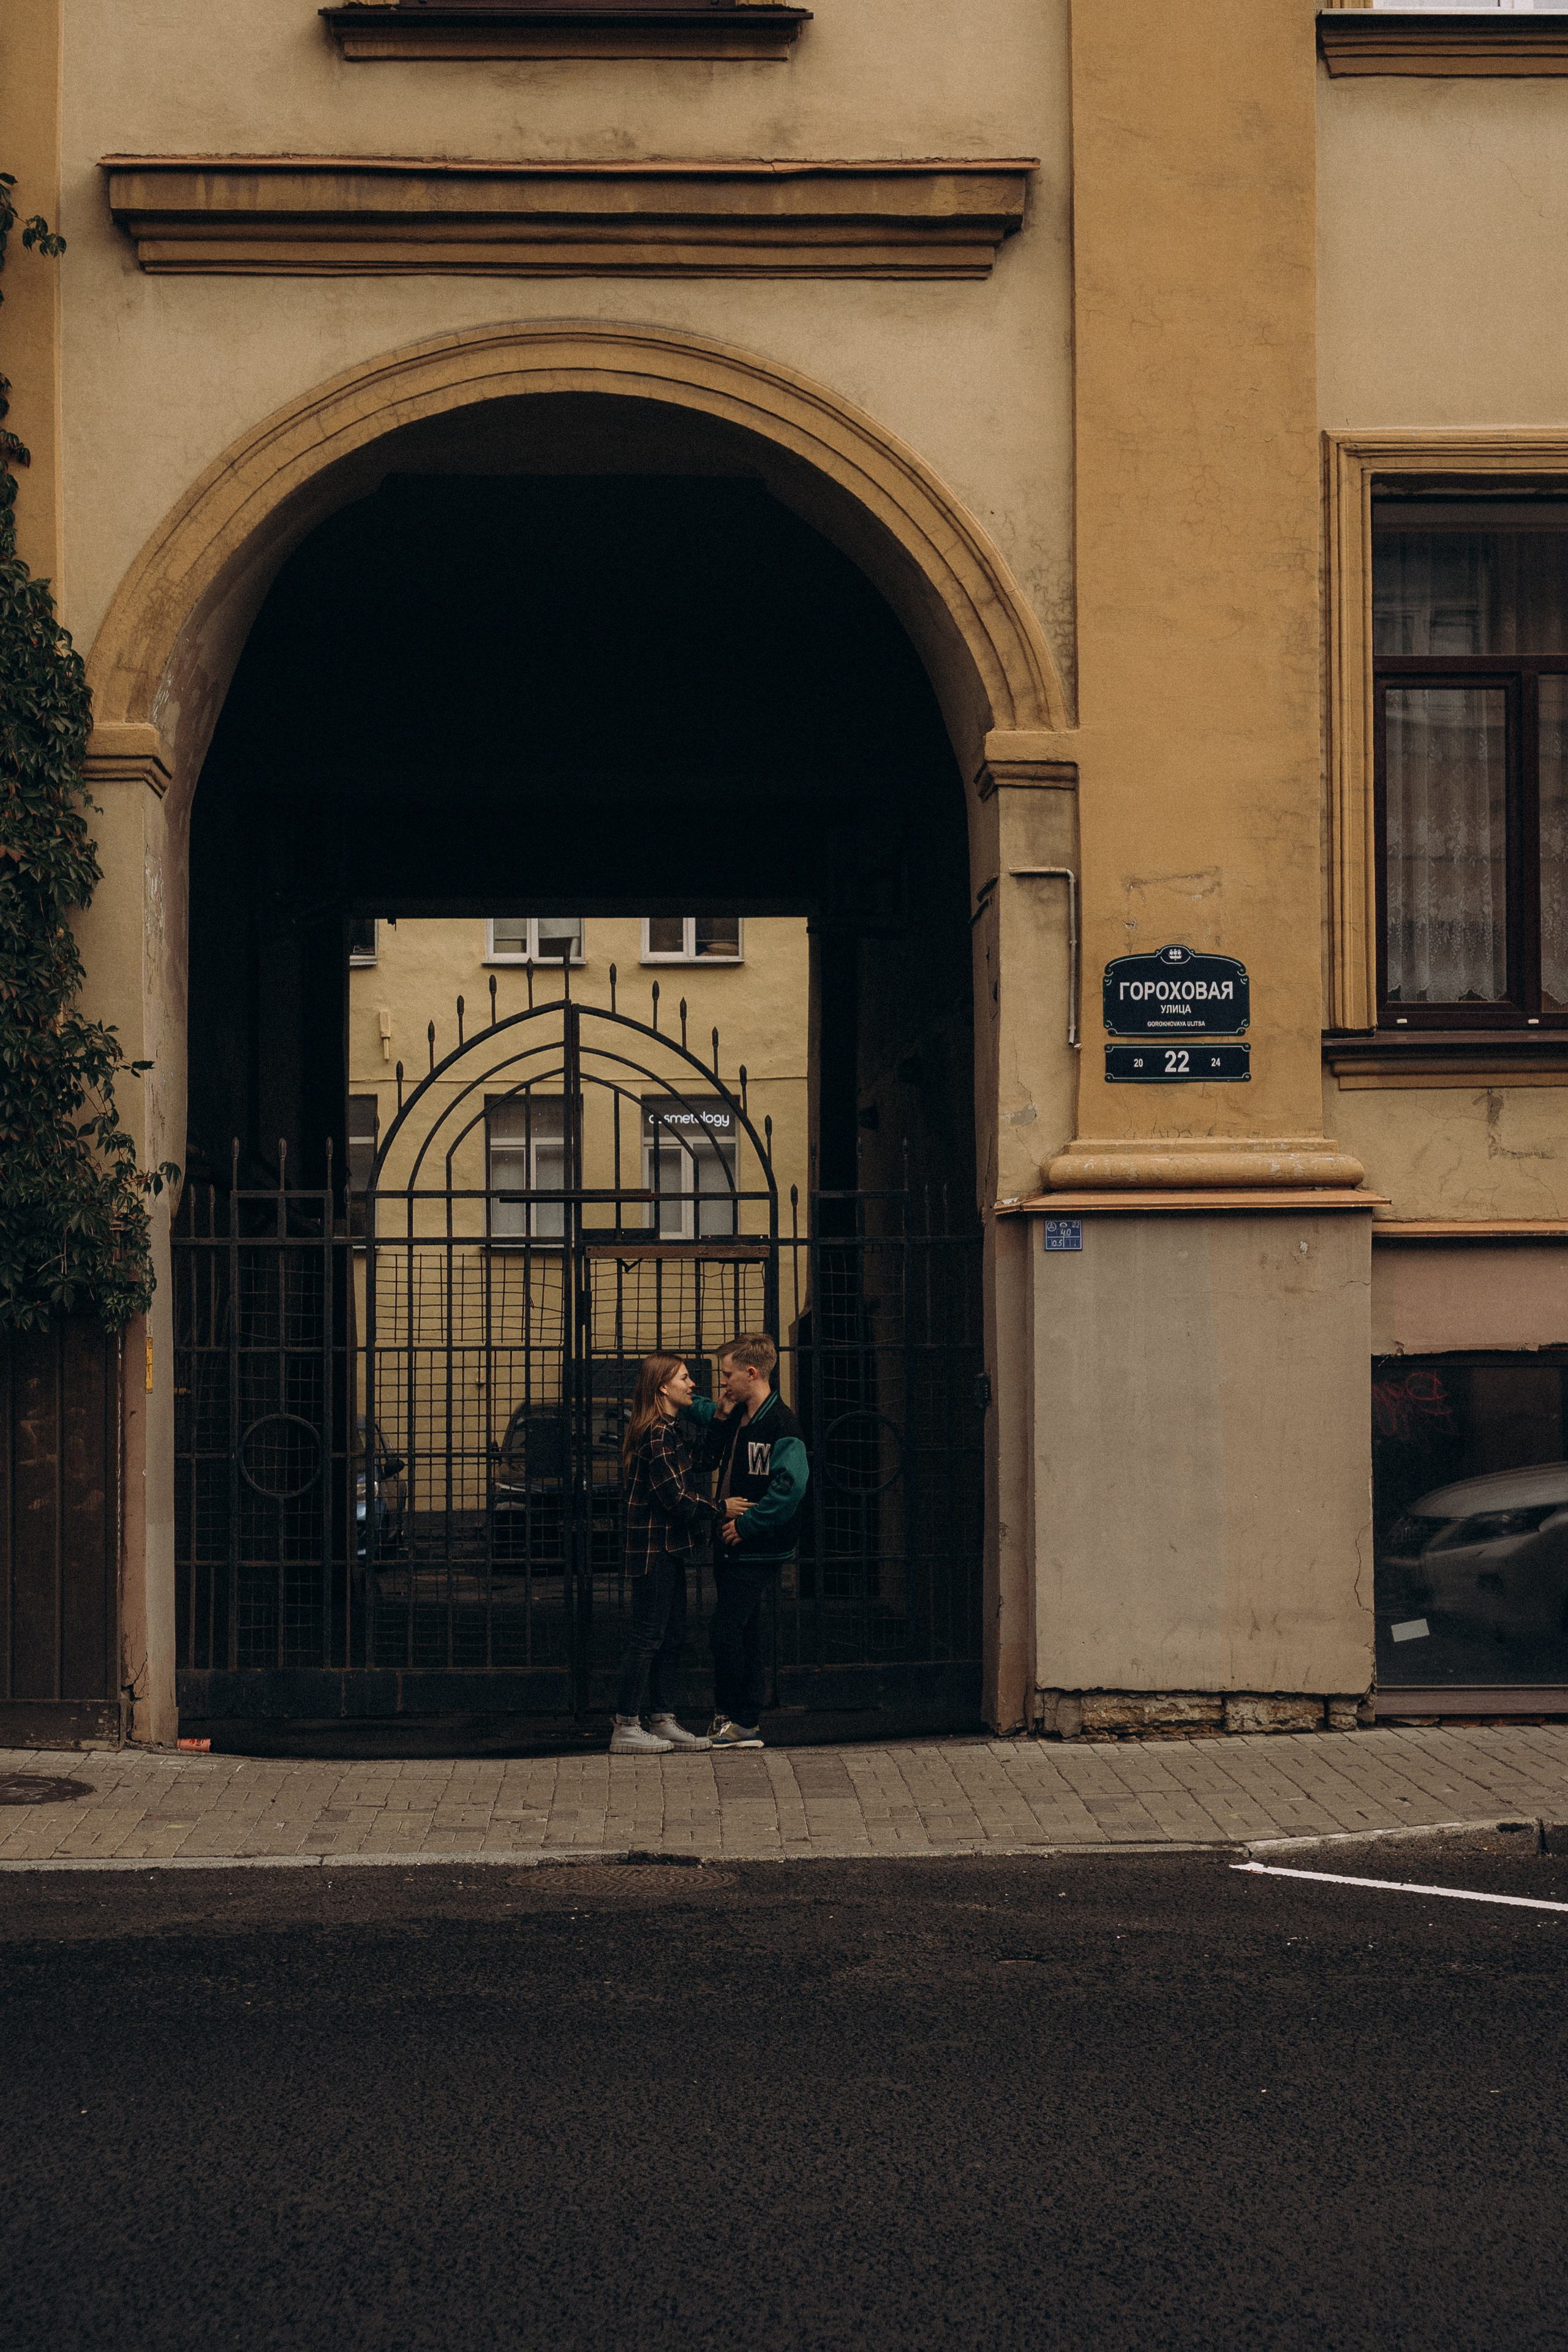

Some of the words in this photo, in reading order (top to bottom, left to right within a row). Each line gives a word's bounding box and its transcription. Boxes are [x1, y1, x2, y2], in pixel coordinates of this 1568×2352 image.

[1119, 981, 1234, 1000] ГОРОХОВАЯ
[1160, 1005, 1192, 1015] УЛИЦА
[1133, 1058, 1144, 1068] 20
[1164, 1050, 1190, 1072] 22
[1211, 1058, 1221, 1067] 24
[649, 1110, 729, 1127] csmetlogy
[748, 1441, 771, 1476] W
